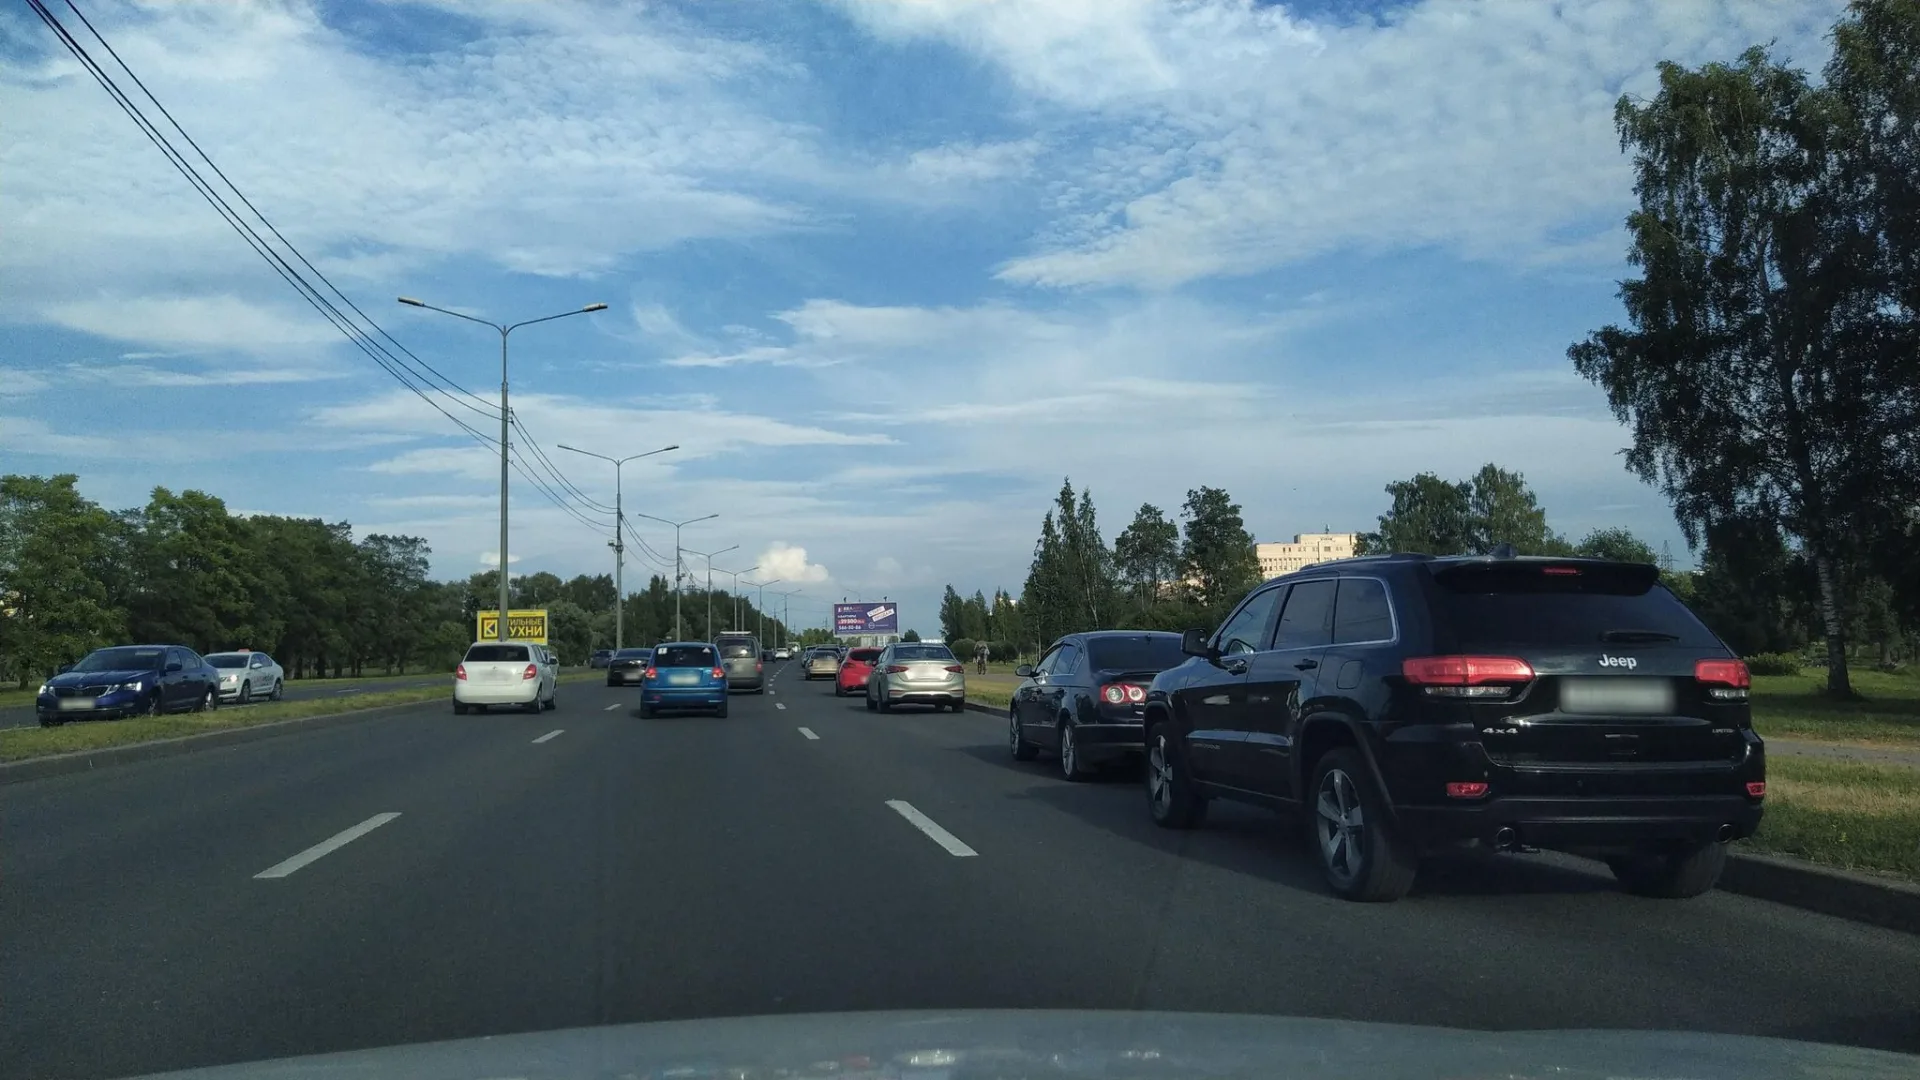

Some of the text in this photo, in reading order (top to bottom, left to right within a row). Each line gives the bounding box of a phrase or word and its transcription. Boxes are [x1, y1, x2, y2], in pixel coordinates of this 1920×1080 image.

[507, 618, 543, 626] ТИЛЬНЫЕ
[509, 626, 543, 637] УХНИ
[1598, 653, 1638, 669] Jeep
